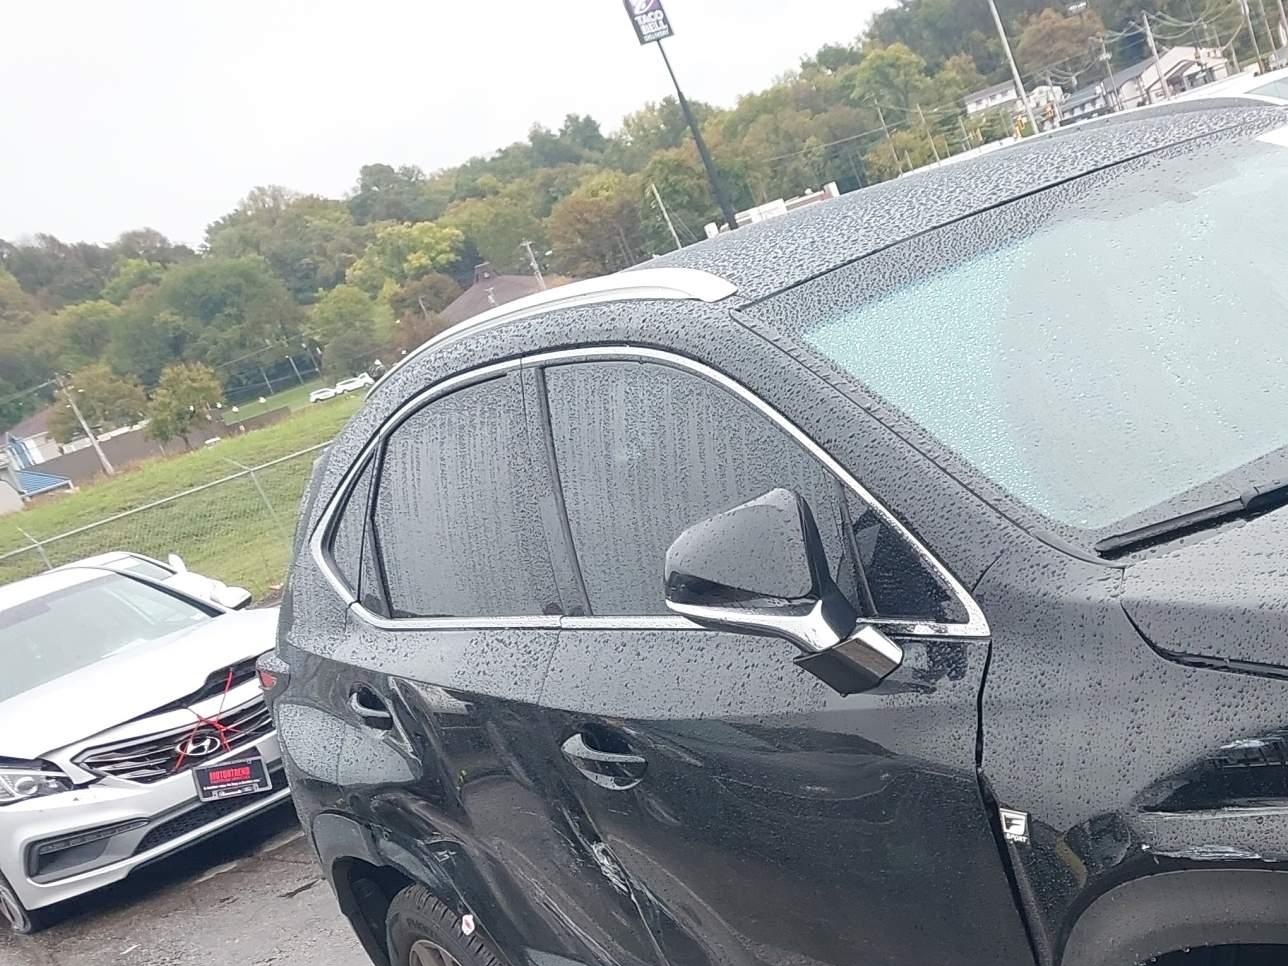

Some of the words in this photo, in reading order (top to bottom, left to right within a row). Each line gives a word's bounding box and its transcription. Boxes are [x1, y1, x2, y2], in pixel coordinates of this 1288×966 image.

[634, 9, 664, 24] TACO
[640, 20, 668, 35] BELL
[1006, 832, 1028, 842] SPORT
